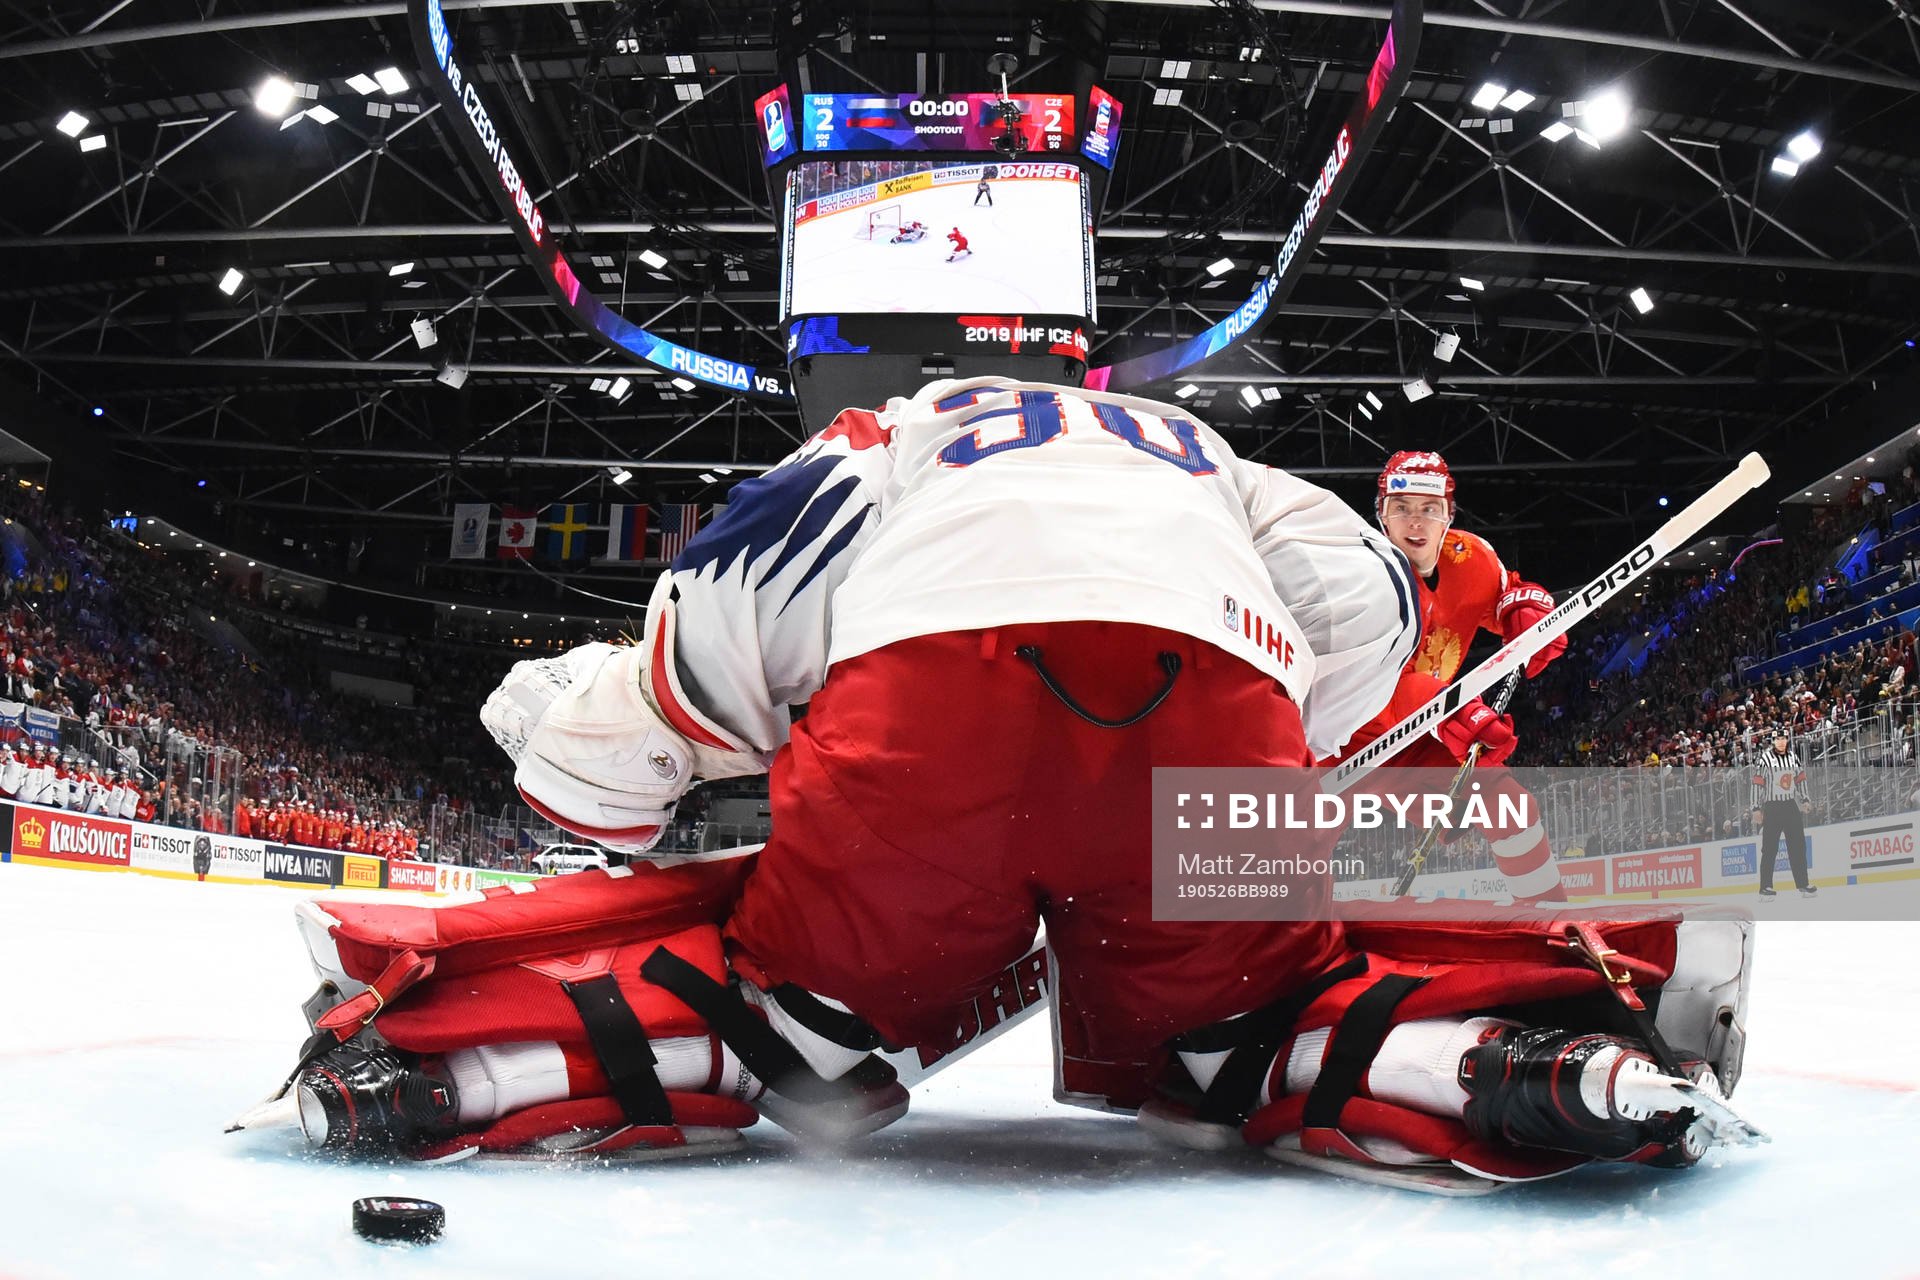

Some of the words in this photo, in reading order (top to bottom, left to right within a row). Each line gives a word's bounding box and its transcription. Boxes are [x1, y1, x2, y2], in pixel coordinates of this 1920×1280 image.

[813, 97, 833, 106] RUS
[909, 101, 969, 116] 00:00
[1045, 99, 1062, 107] CZE
[816, 108, 834, 131] 2
[914, 126, 964, 134] SHOOTOUT
[1044, 109, 1062, 132] 2
[817, 140, 828, 148] 30
[463, 82, 500, 163] CZECH
[498, 147, 542, 242] REPUBLIC
[948, 168, 980, 177] TISSOT
[1001, 165, 1079, 180] ФОНБЕТ
[1225, 285, 1268, 342] RUSSIA
[1278, 220, 1306, 278] CZECH
[1305, 128, 1349, 229] REPUBLIC
[966, 327, 1009, 342] 2019
[1015, 328, 1044, 342] IIHF
[1048, 328, 1072, 345] ICE
[671, 348, 749, 388] RUSSIA
[1538, 598, 1580, 633] CUSTOM
[1581, 544, 1654, 608] PRO
[1244, 608, 1294, 671] IIHF
[1337, 702, 1440, 782] WARRIOR
[49, 820, 127, 859] KRUŠOVICE
[151, 835, 191, 854] TISSOT
[1850, 834, 1914, 860] STRABAG
[229, 847, 262, 863] TISSOT
[265, 851, 302, 876] NIVEA
[303, 857, 331, 878] MEN
[347, 863, 376, 881] PIRELLI
[1618, 866, 1695, 889] #BRATISLAVA
